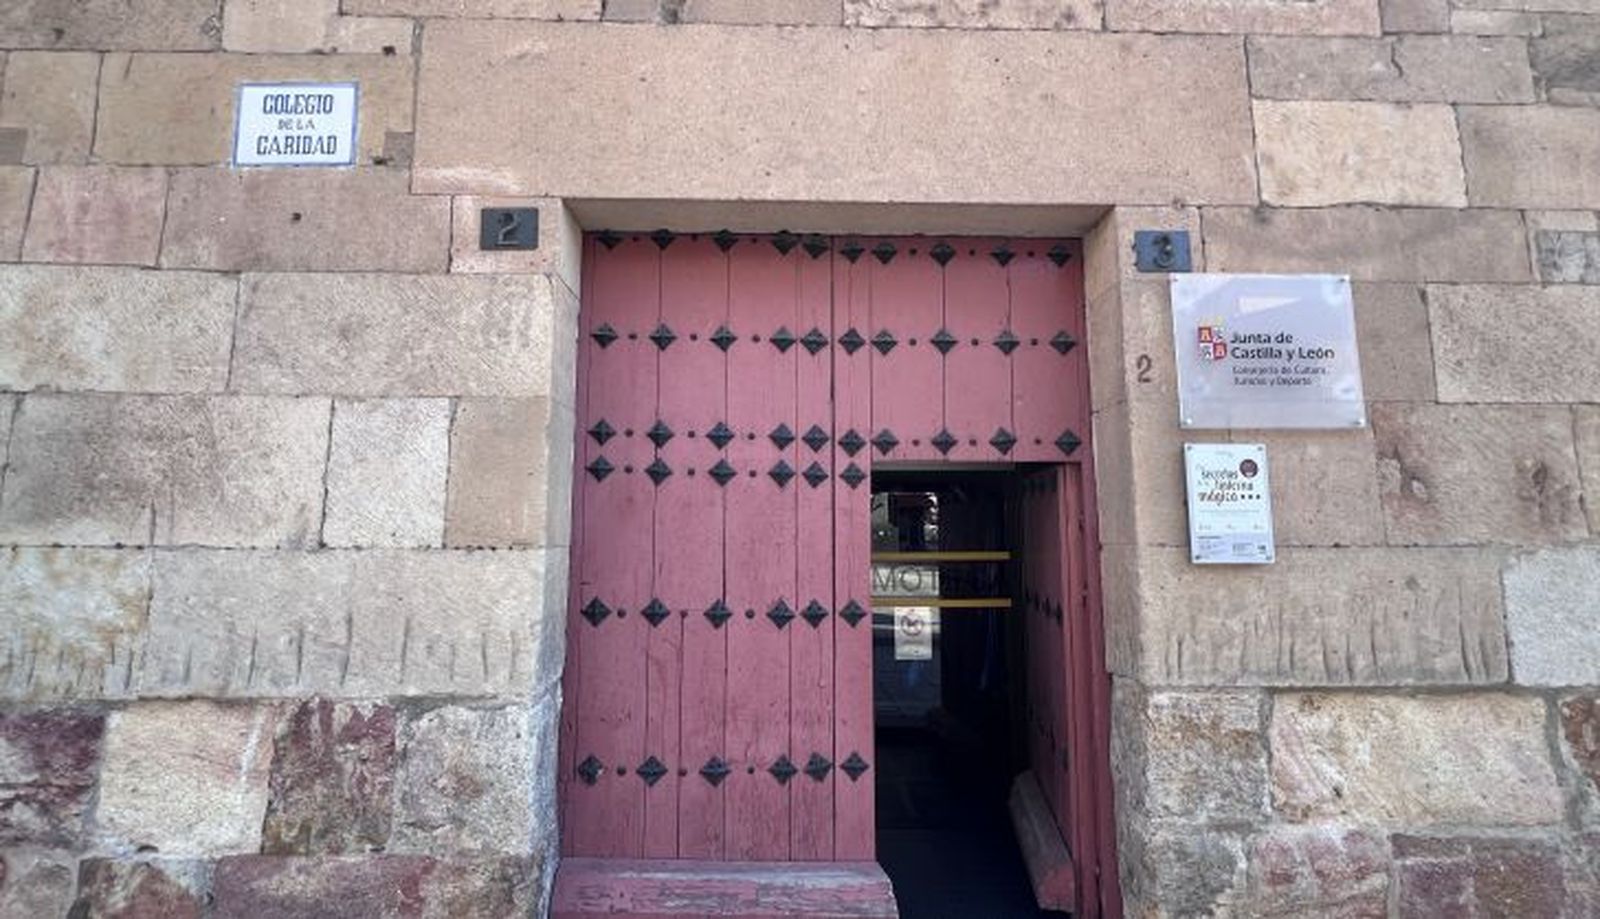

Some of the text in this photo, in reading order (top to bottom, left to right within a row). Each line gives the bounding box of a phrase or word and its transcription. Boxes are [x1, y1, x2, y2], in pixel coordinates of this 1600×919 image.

[263, 94, 334, 115] COLEGIO
[278, 119, 315, 130] DE LA
[256, 135, 337, 155] CARIDAD
[497, 210, 520, 246] 2
[1153, 235, 1174, 268] 3
[1230, 332, 1293, 344] Junta de
[1231, 347, 1335, 361] Castilla y León
[1136, 354, 1152, 383] 2
